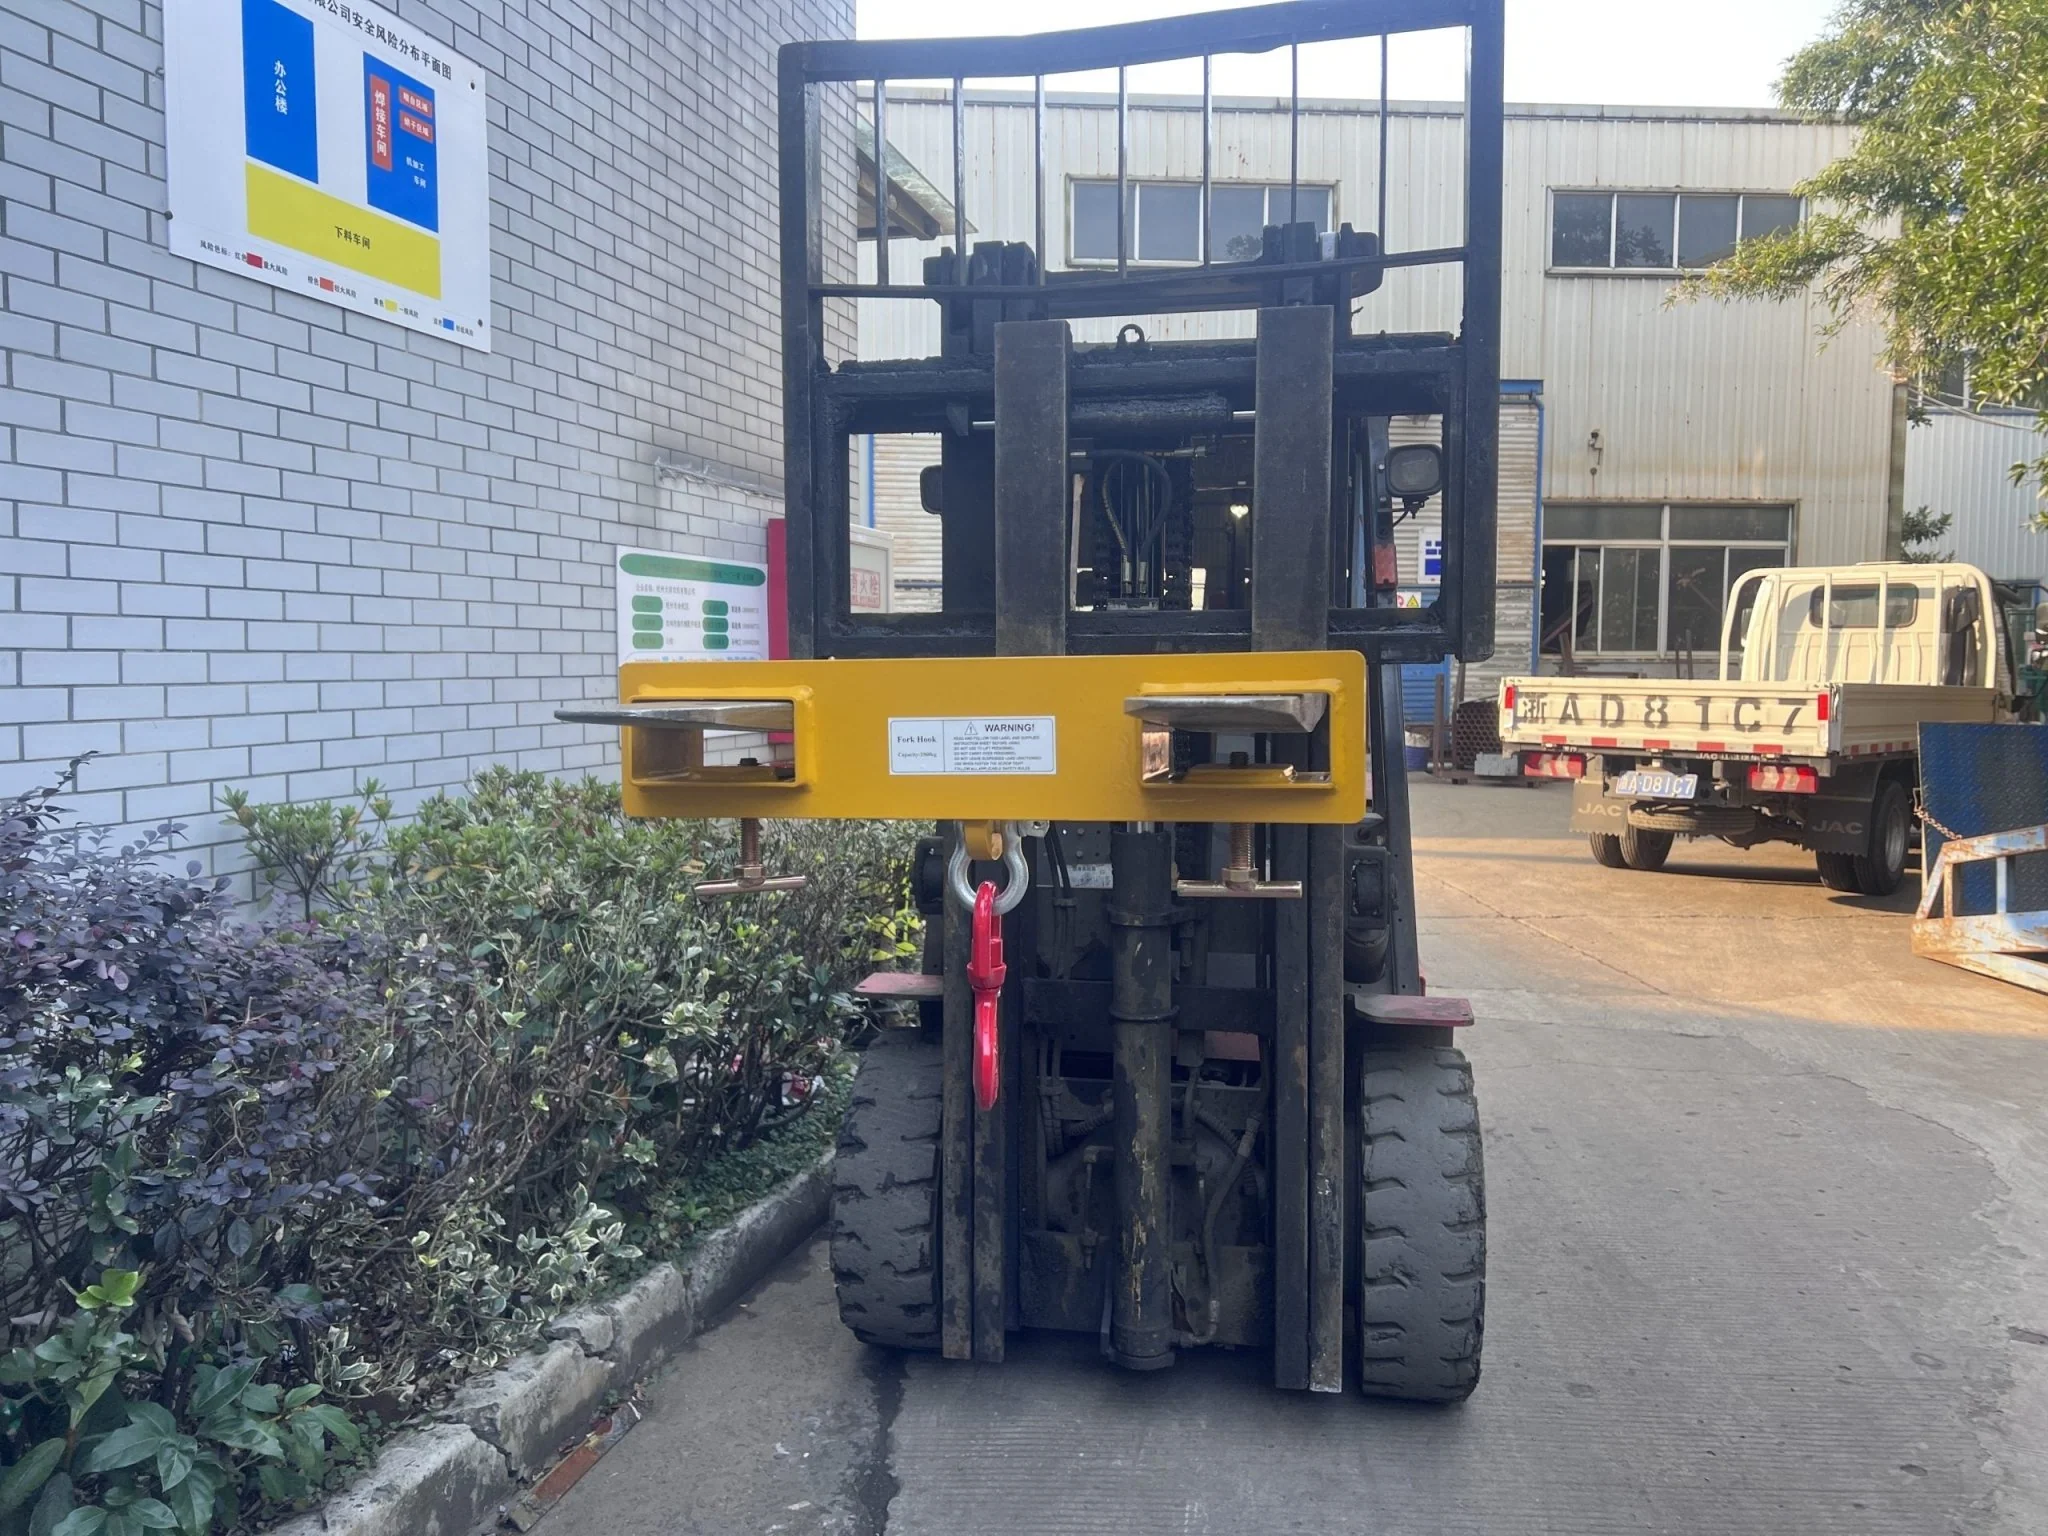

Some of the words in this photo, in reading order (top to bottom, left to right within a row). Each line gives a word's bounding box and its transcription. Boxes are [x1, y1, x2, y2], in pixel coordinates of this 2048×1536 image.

[311, 0, 452, 80] 限公司安全风险分布平面图
[274, 60, 288, 115] 办公楼
[374, 90, 388, 157] 焊接车间
[406, 156, 425, 172] 机加工
[414, 175, 427, 189] 车间
[335, 225, 371, 250] 下料车间
[985, 723, 1036, 733] WARNING!
[897, 735, 915, 743] Fork
[917, 735, 937, 743] Hook
[1577, 802, 1623, 818] JAC
[1812, 819, 1864, 835] JAC
